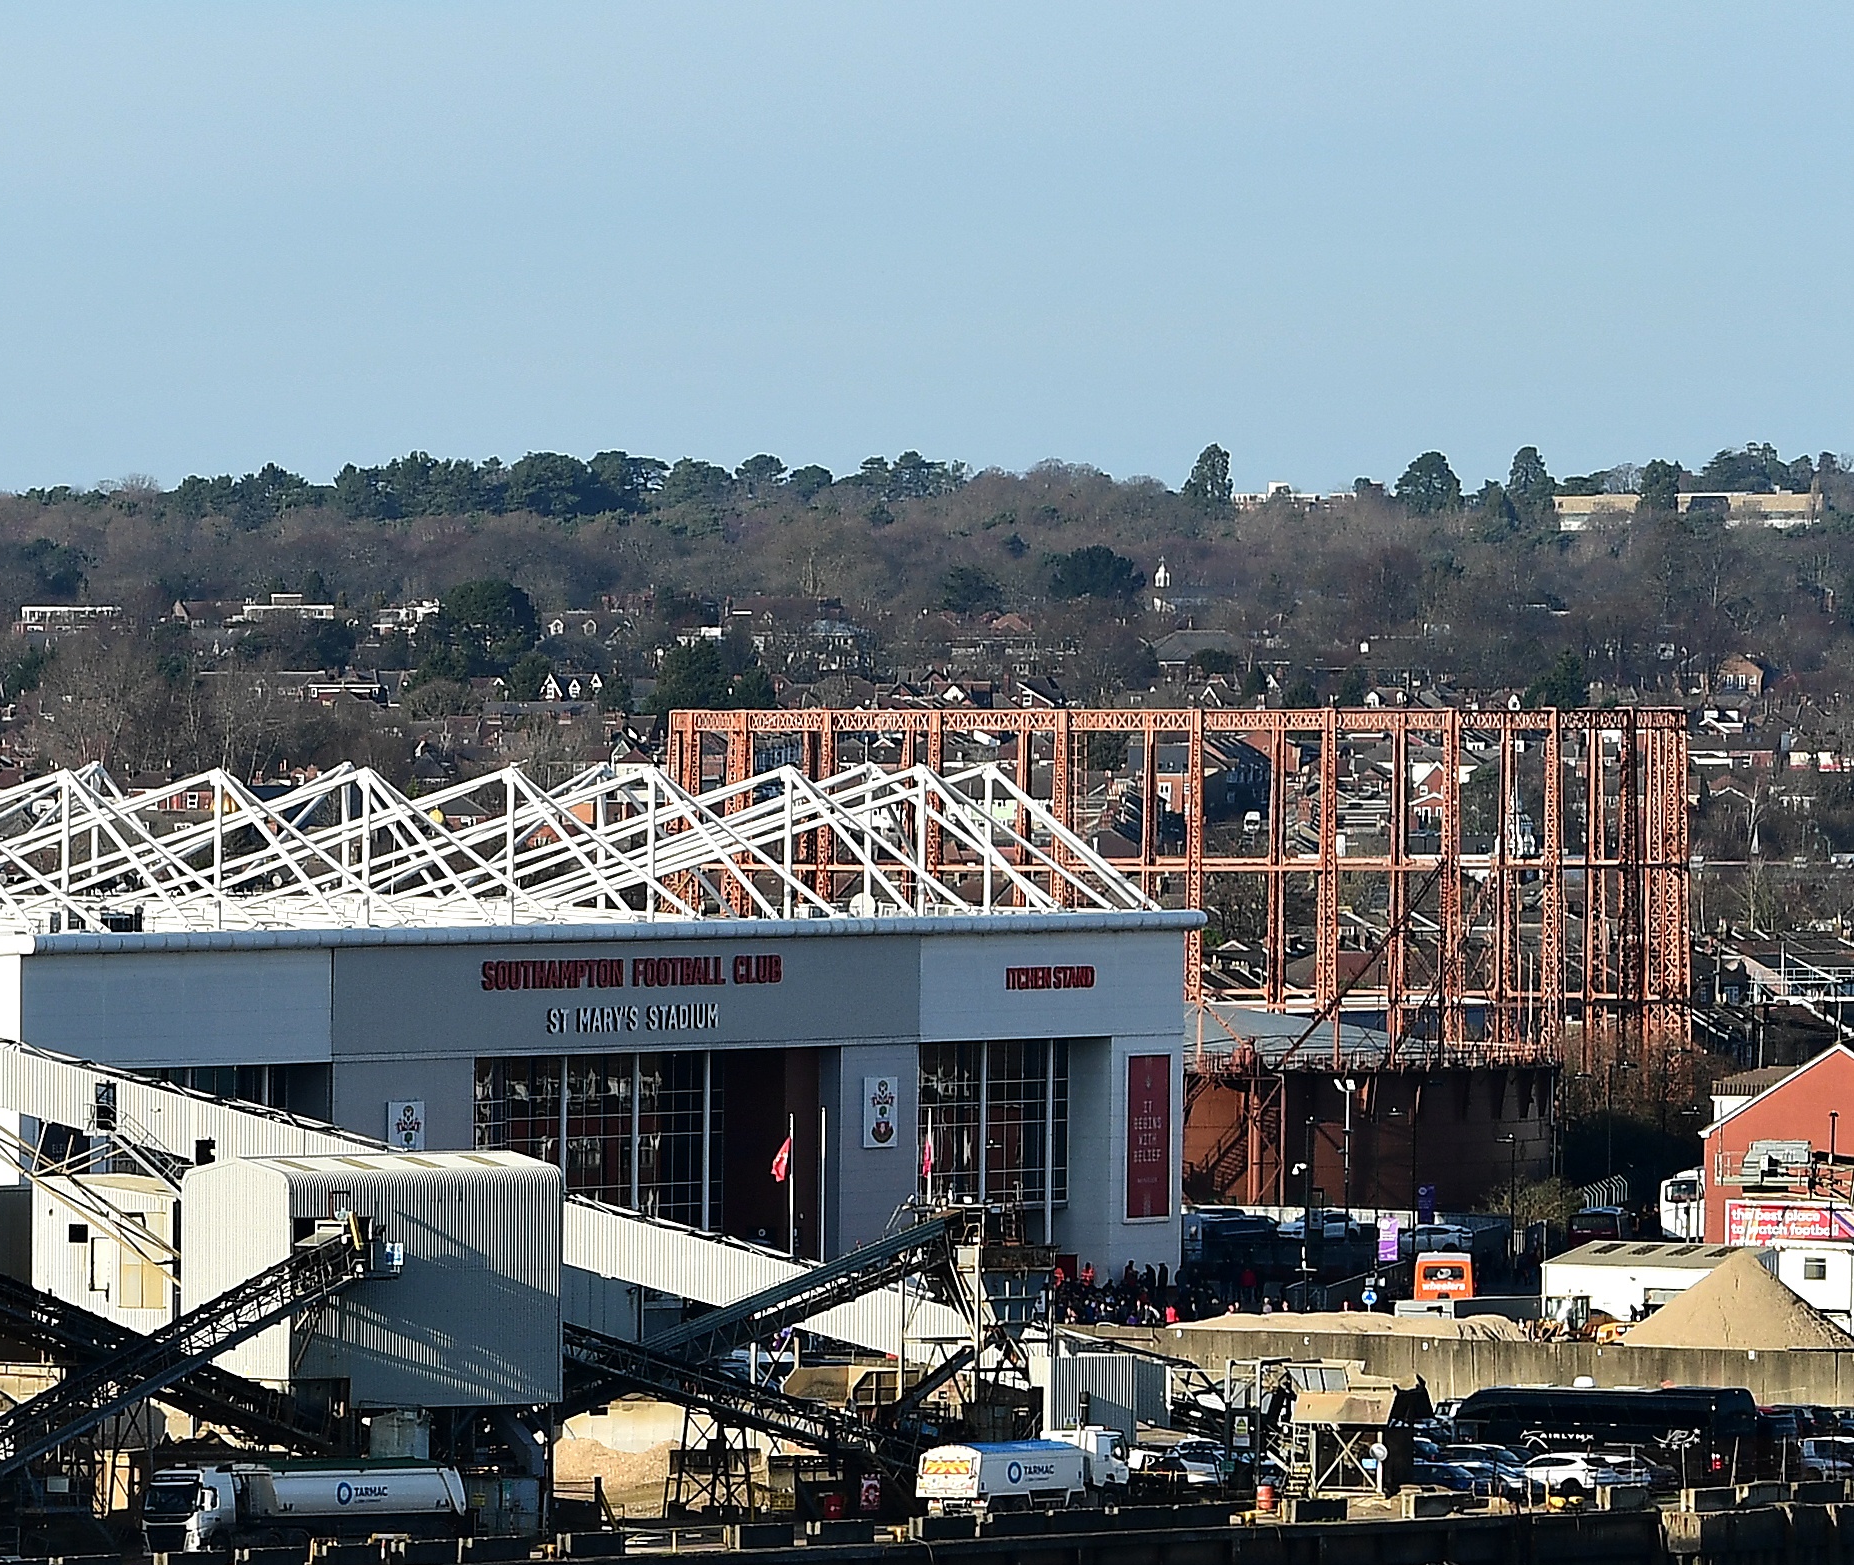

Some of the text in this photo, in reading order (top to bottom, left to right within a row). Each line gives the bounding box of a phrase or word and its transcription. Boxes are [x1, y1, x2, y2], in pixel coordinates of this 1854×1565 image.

[481, 954, 783, 991] SOUTHAMPTON FOOTBALL CLUB
[1005, 965, 1095, 989] ITCHEN STAND
[546, 1003, 719, 1034] ST MARY'S STADIUM
[1731, 1208, 1820, 1224] the best place
[1731, 1224, 1746, 1235] to
[1750, 1223, 1787, 1236] watch
[1422, 1281, 1466, 1291] wheelers
[1540, 1432, 1594, 1442] AIRLYNX
[1024, 1465, 1054, 1474] TARMAC
[354, 1486, 388, 1497] TARMAC
